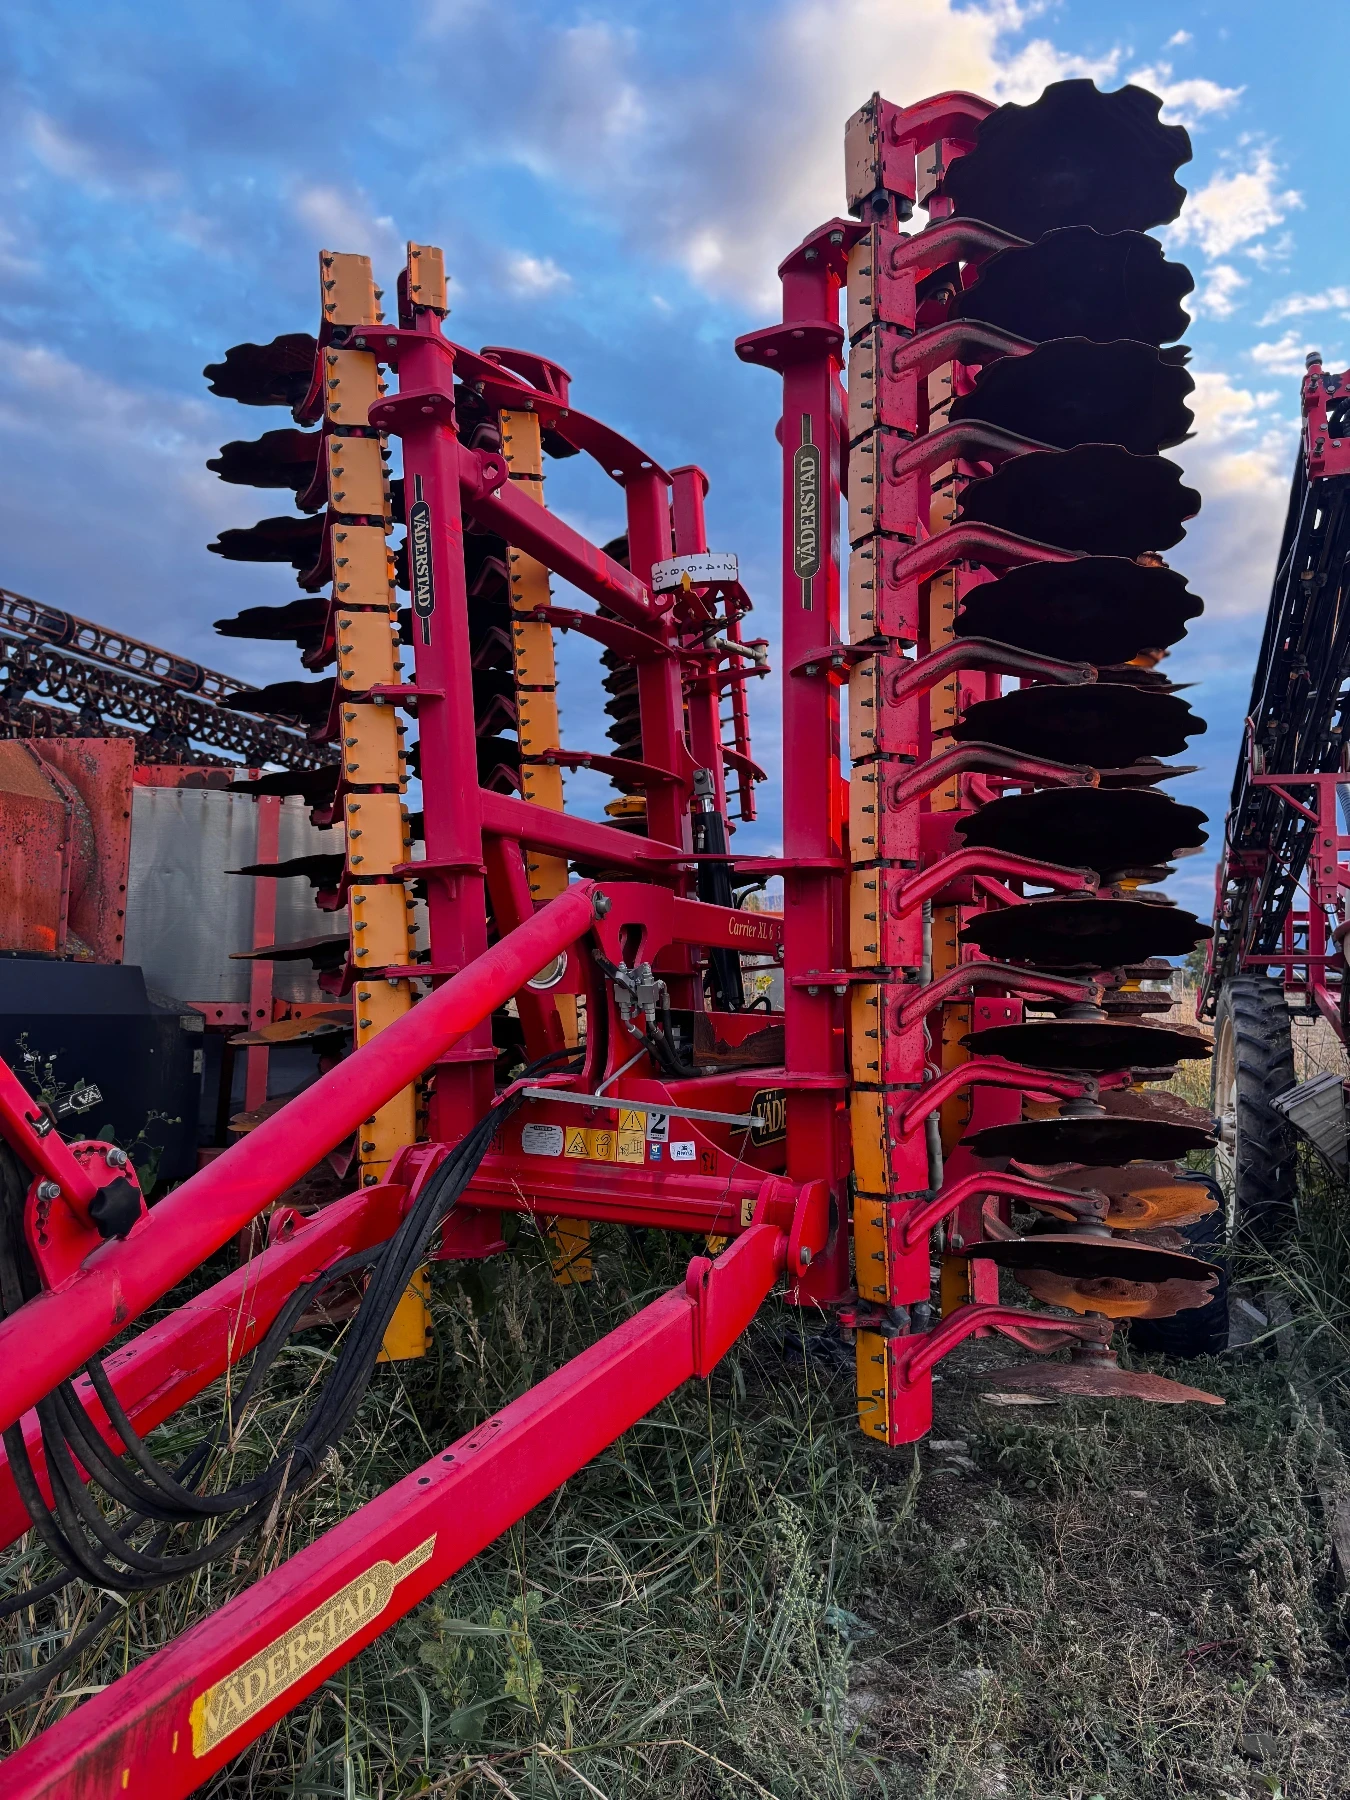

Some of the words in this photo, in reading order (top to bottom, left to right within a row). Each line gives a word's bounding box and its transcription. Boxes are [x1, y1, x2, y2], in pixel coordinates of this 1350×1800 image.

[797, 456, 816, 568] VÄDERSTAD
[413, 509, 431, 607] VÄDERSTAD
[670, 568, 680, 576] 8
[687, 565, 697, 573] 6
[705, 563, 715, 571] 4
[723, 563, 733, 571] 2
[654, 569, 664, 583] 10
[728, 916, 757, 938] Carrier
[203, 1581, 378, 1732] VÄDERSTAD
